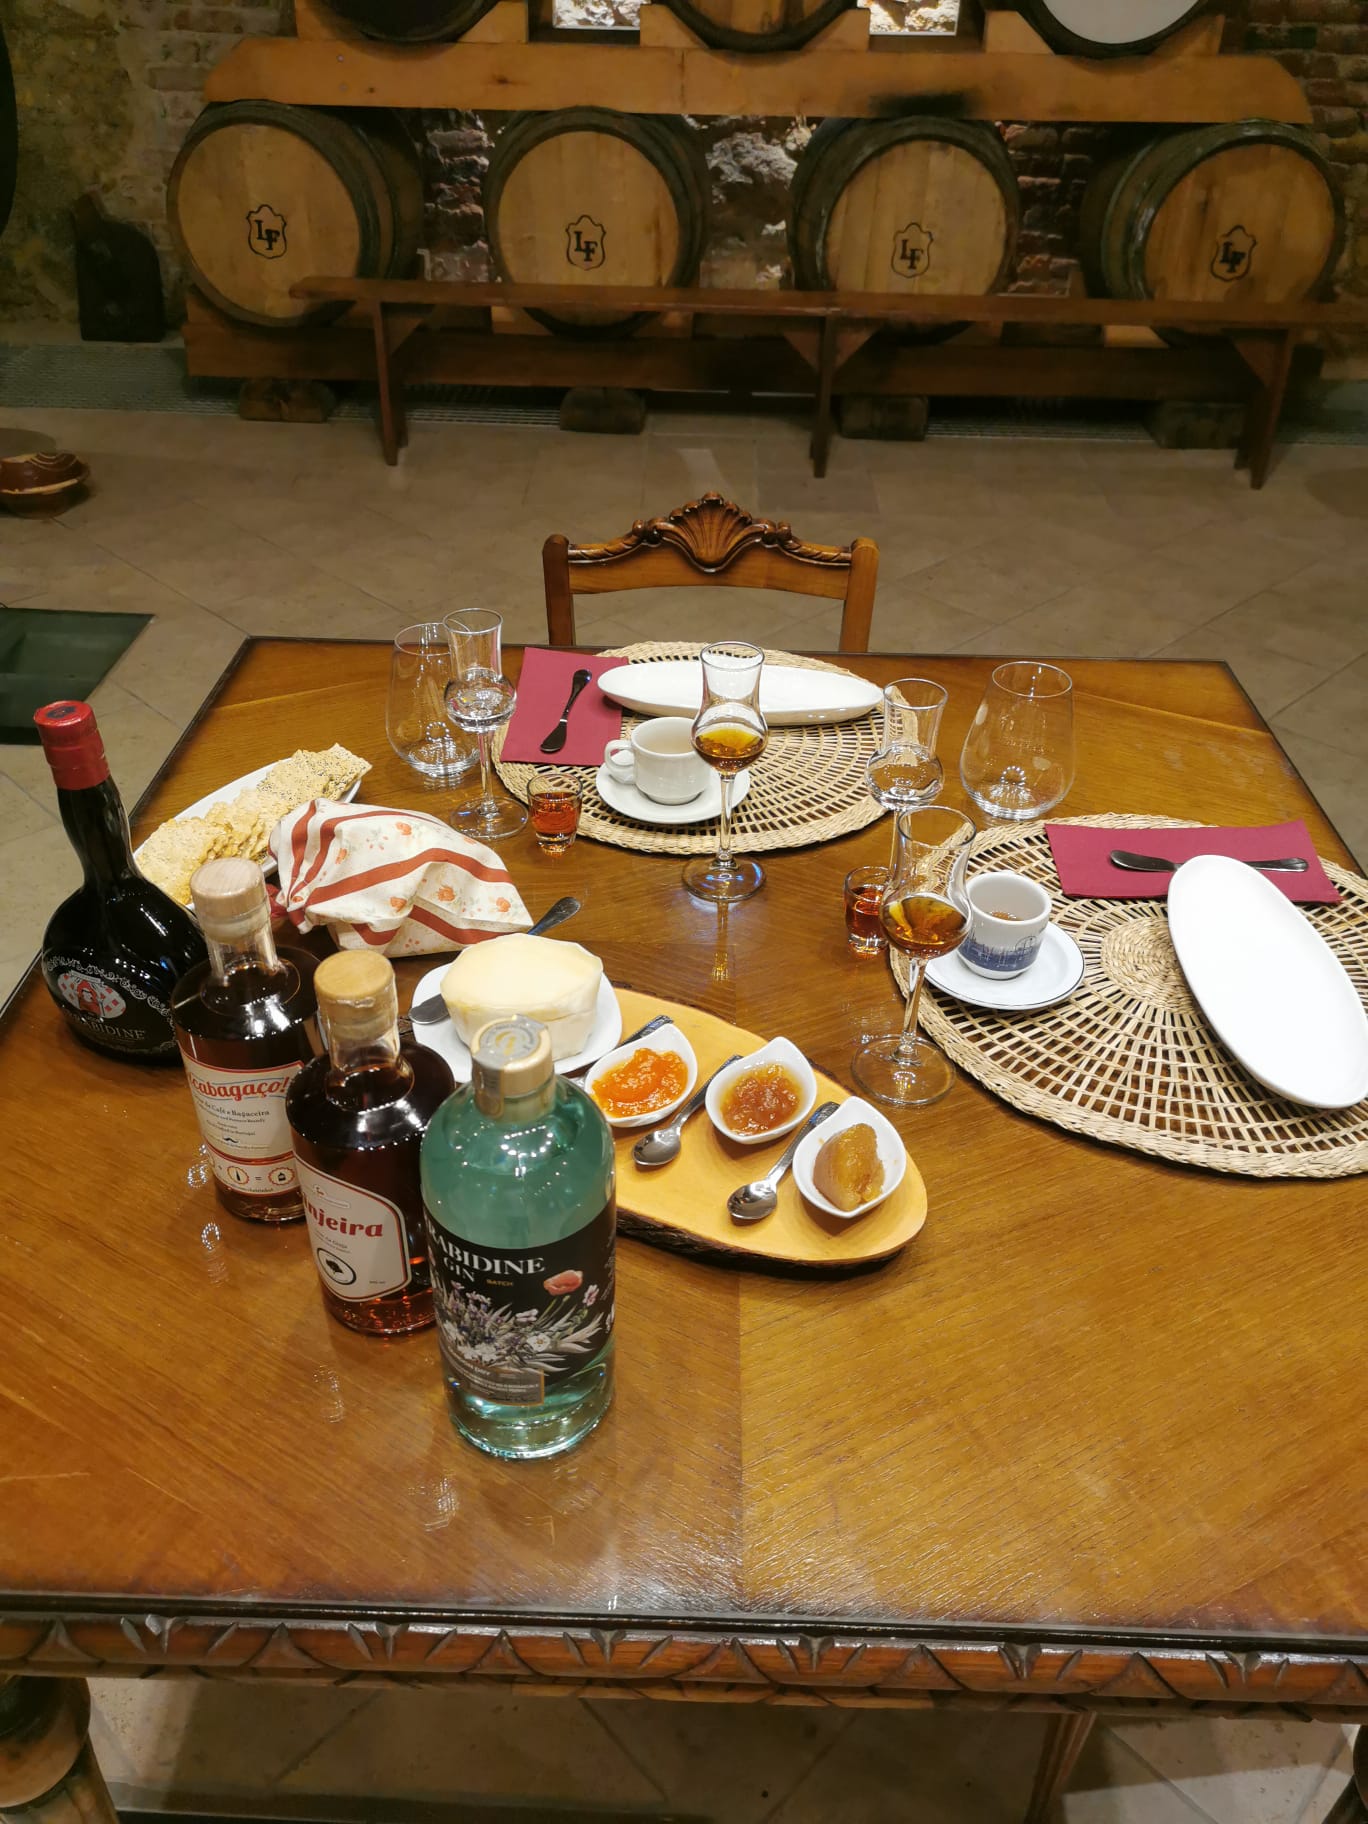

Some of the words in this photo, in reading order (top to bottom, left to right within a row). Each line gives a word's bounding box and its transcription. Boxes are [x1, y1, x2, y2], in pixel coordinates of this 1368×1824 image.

[254, 219, 280, 251] LF
[574, 231, 598, 262] LF
[900, 239, 924, 270] LF
[1220, 241, 1246, 273] LF
[443, 1257, 476, 1283] GIN
